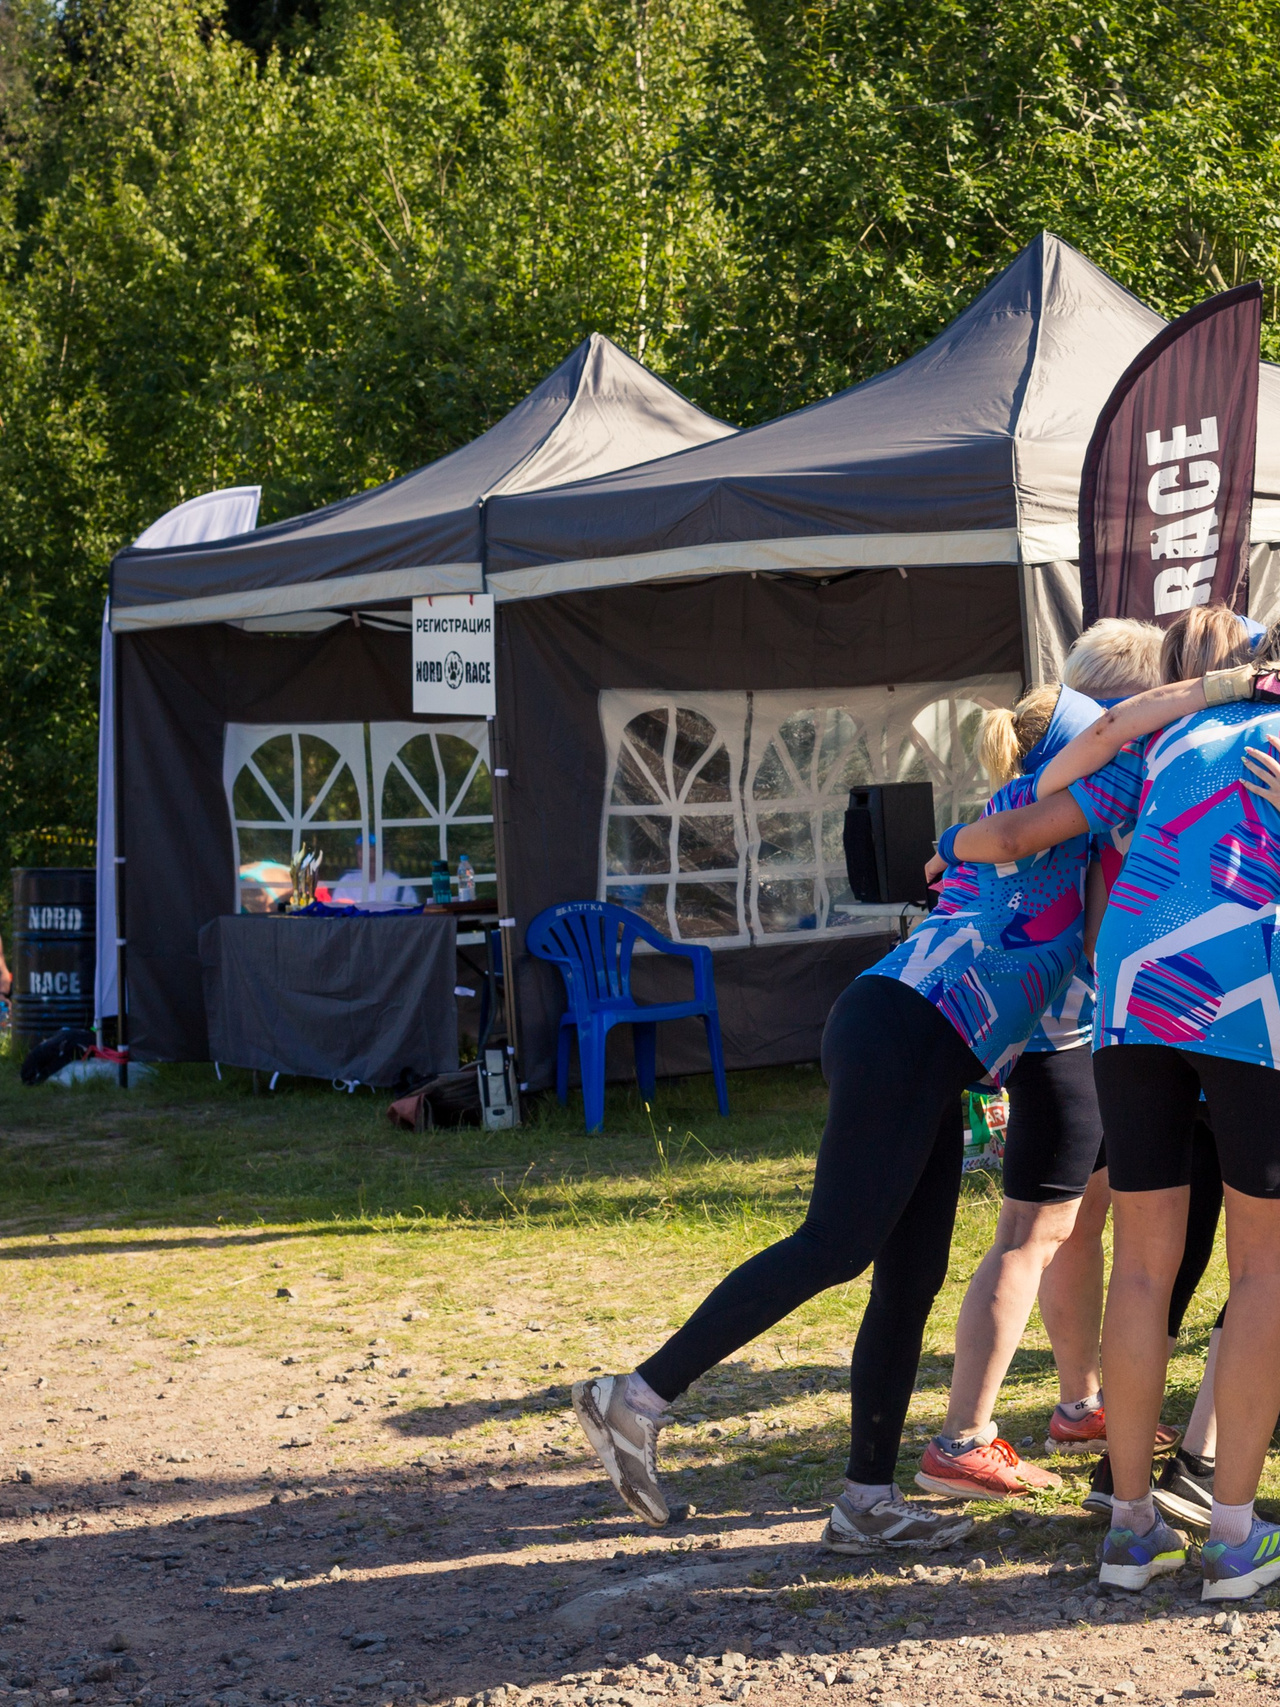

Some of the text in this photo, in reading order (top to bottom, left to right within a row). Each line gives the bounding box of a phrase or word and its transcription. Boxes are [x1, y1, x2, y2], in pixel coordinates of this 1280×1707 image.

[1146, 416, 1221, 616] RACE
[416, 618, 491, 635] РЕГИСТРАЦИЯ
[416, 661, 491, 684] NORD RACE
[28, 906, 82, 931] NORD
[29, 971, 81, 995] RACE
